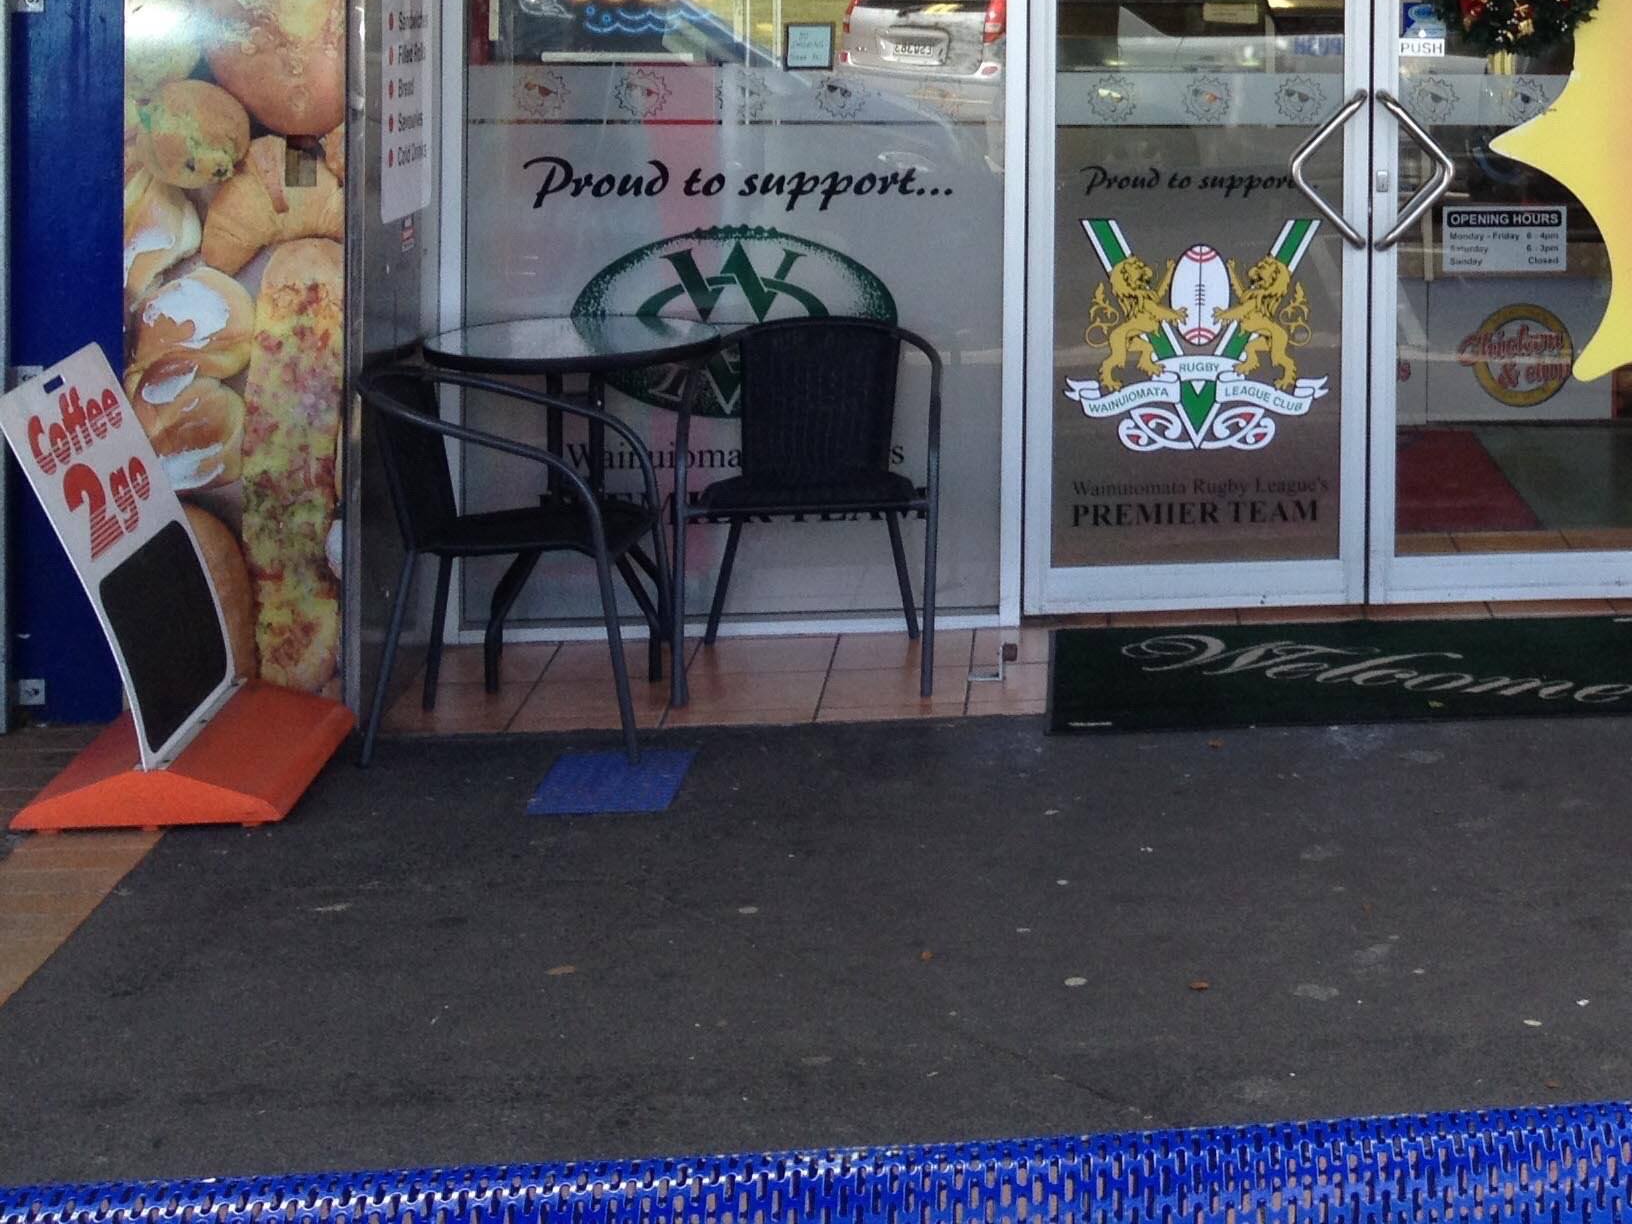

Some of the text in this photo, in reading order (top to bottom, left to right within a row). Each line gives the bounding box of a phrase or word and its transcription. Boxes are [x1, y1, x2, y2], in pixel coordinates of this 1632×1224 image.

[1400, 41, 1443, 54] PUSH
[523, 156, 954, 212] Proud to support...
[1080, 165, 1159, 196] Proud
[1168, 172, 1191, 189] to
[1450, 213, 1559, 225] OPENING HOURS
[1528, 257, 1559, 265] Closed
[1178, 361, 1221, 373] RUGBY
[1088, 386, 1304, 414] WAINUIOMATA LEAGUE CLUB
[27, 385, 124, 475] Coffee
[1072, 476, 1329, 498] Wainuiomata Rugby League's
[1072, 498, 1318, 527] PREMIER TEAM
